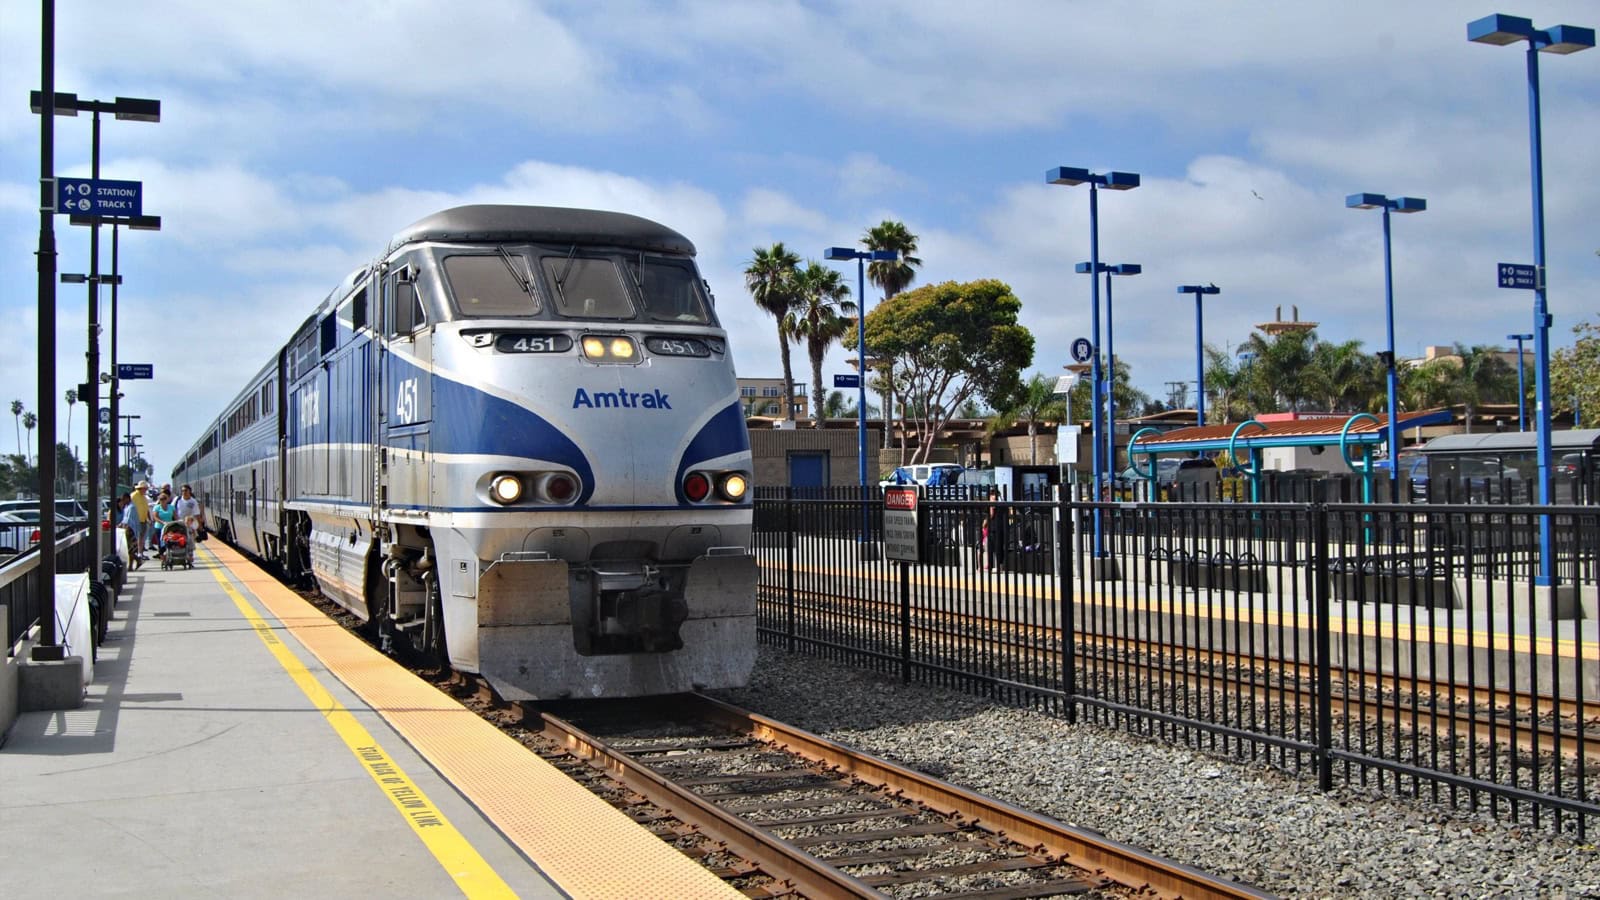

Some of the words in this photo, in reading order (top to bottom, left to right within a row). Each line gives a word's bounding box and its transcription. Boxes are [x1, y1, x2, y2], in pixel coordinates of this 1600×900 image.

[97, 188, 136, 197] STATION/
[98, 200, 126, 209] TRACK
[128, 201, 133, 209] 1
[513, 337, 556, 352] 451
[662, 341, 695, 354] 451
[397, 377, 418, 425] 451
[572, 388, 672, 409] Amtrak
[887, 493, 914, 506] DANGER
[357, 747, 384, 761] STAND
[369, 763, 397, 776] BACK
[388, 786, 428, 808] YELLOW
[410, 811, 444, 828] LINE
